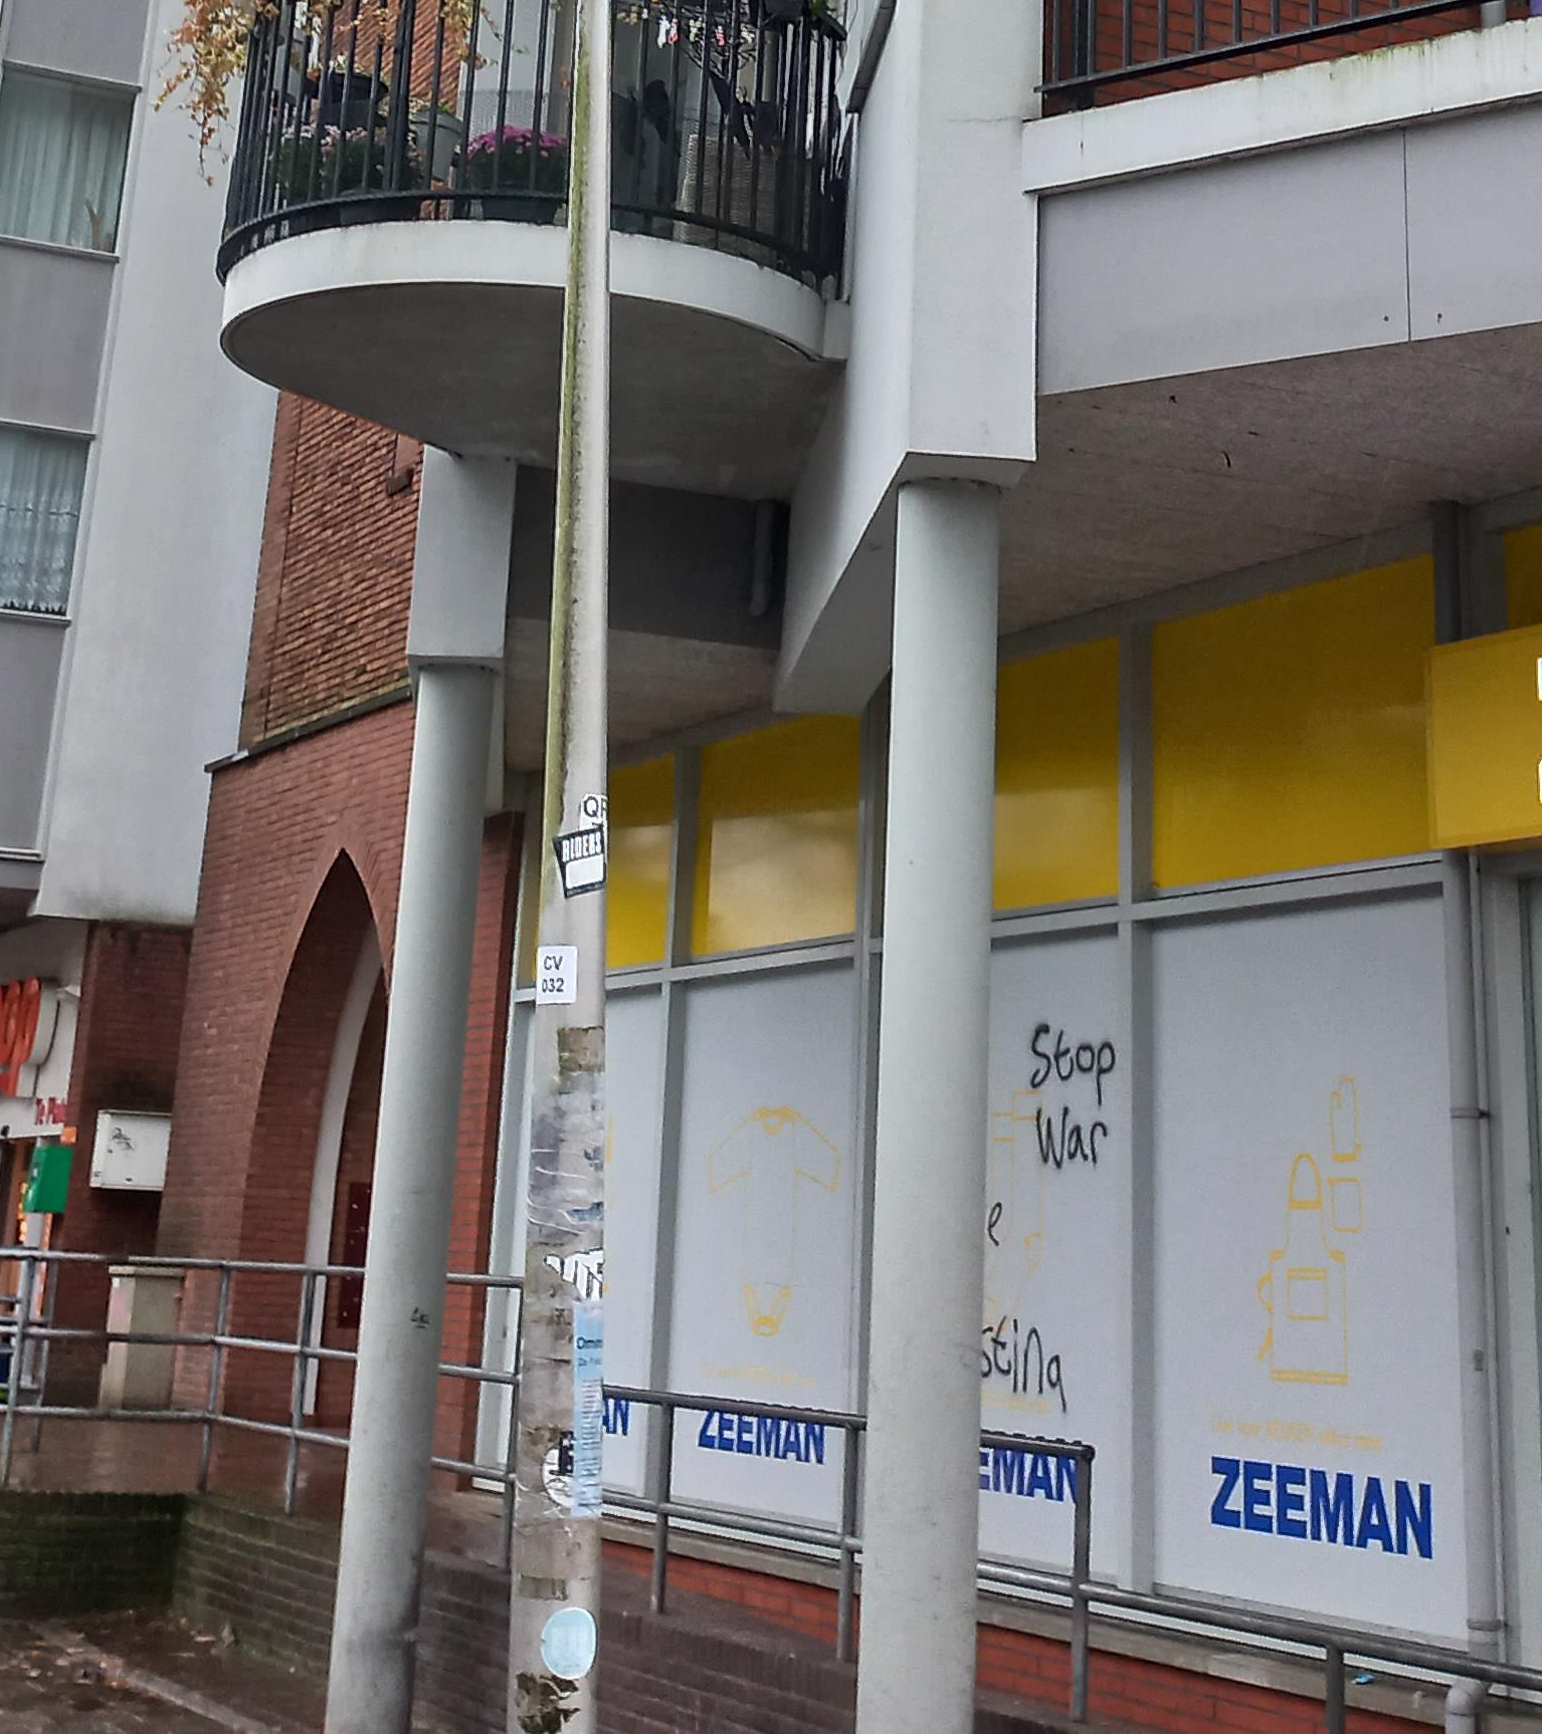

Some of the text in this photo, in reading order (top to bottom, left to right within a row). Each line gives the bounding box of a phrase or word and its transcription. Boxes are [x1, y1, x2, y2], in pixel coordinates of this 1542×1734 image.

[541, 978, 564, 993] 032
[543, 955, 563, 971] CV
[1030, 1024, 1116, 1106] Stop
[1036, 1107, 1108, 1169] War
[698, 1411, 825, 1465] ZEEMAN
[1211, 1456, 1434, 1560] ZEEMAN
